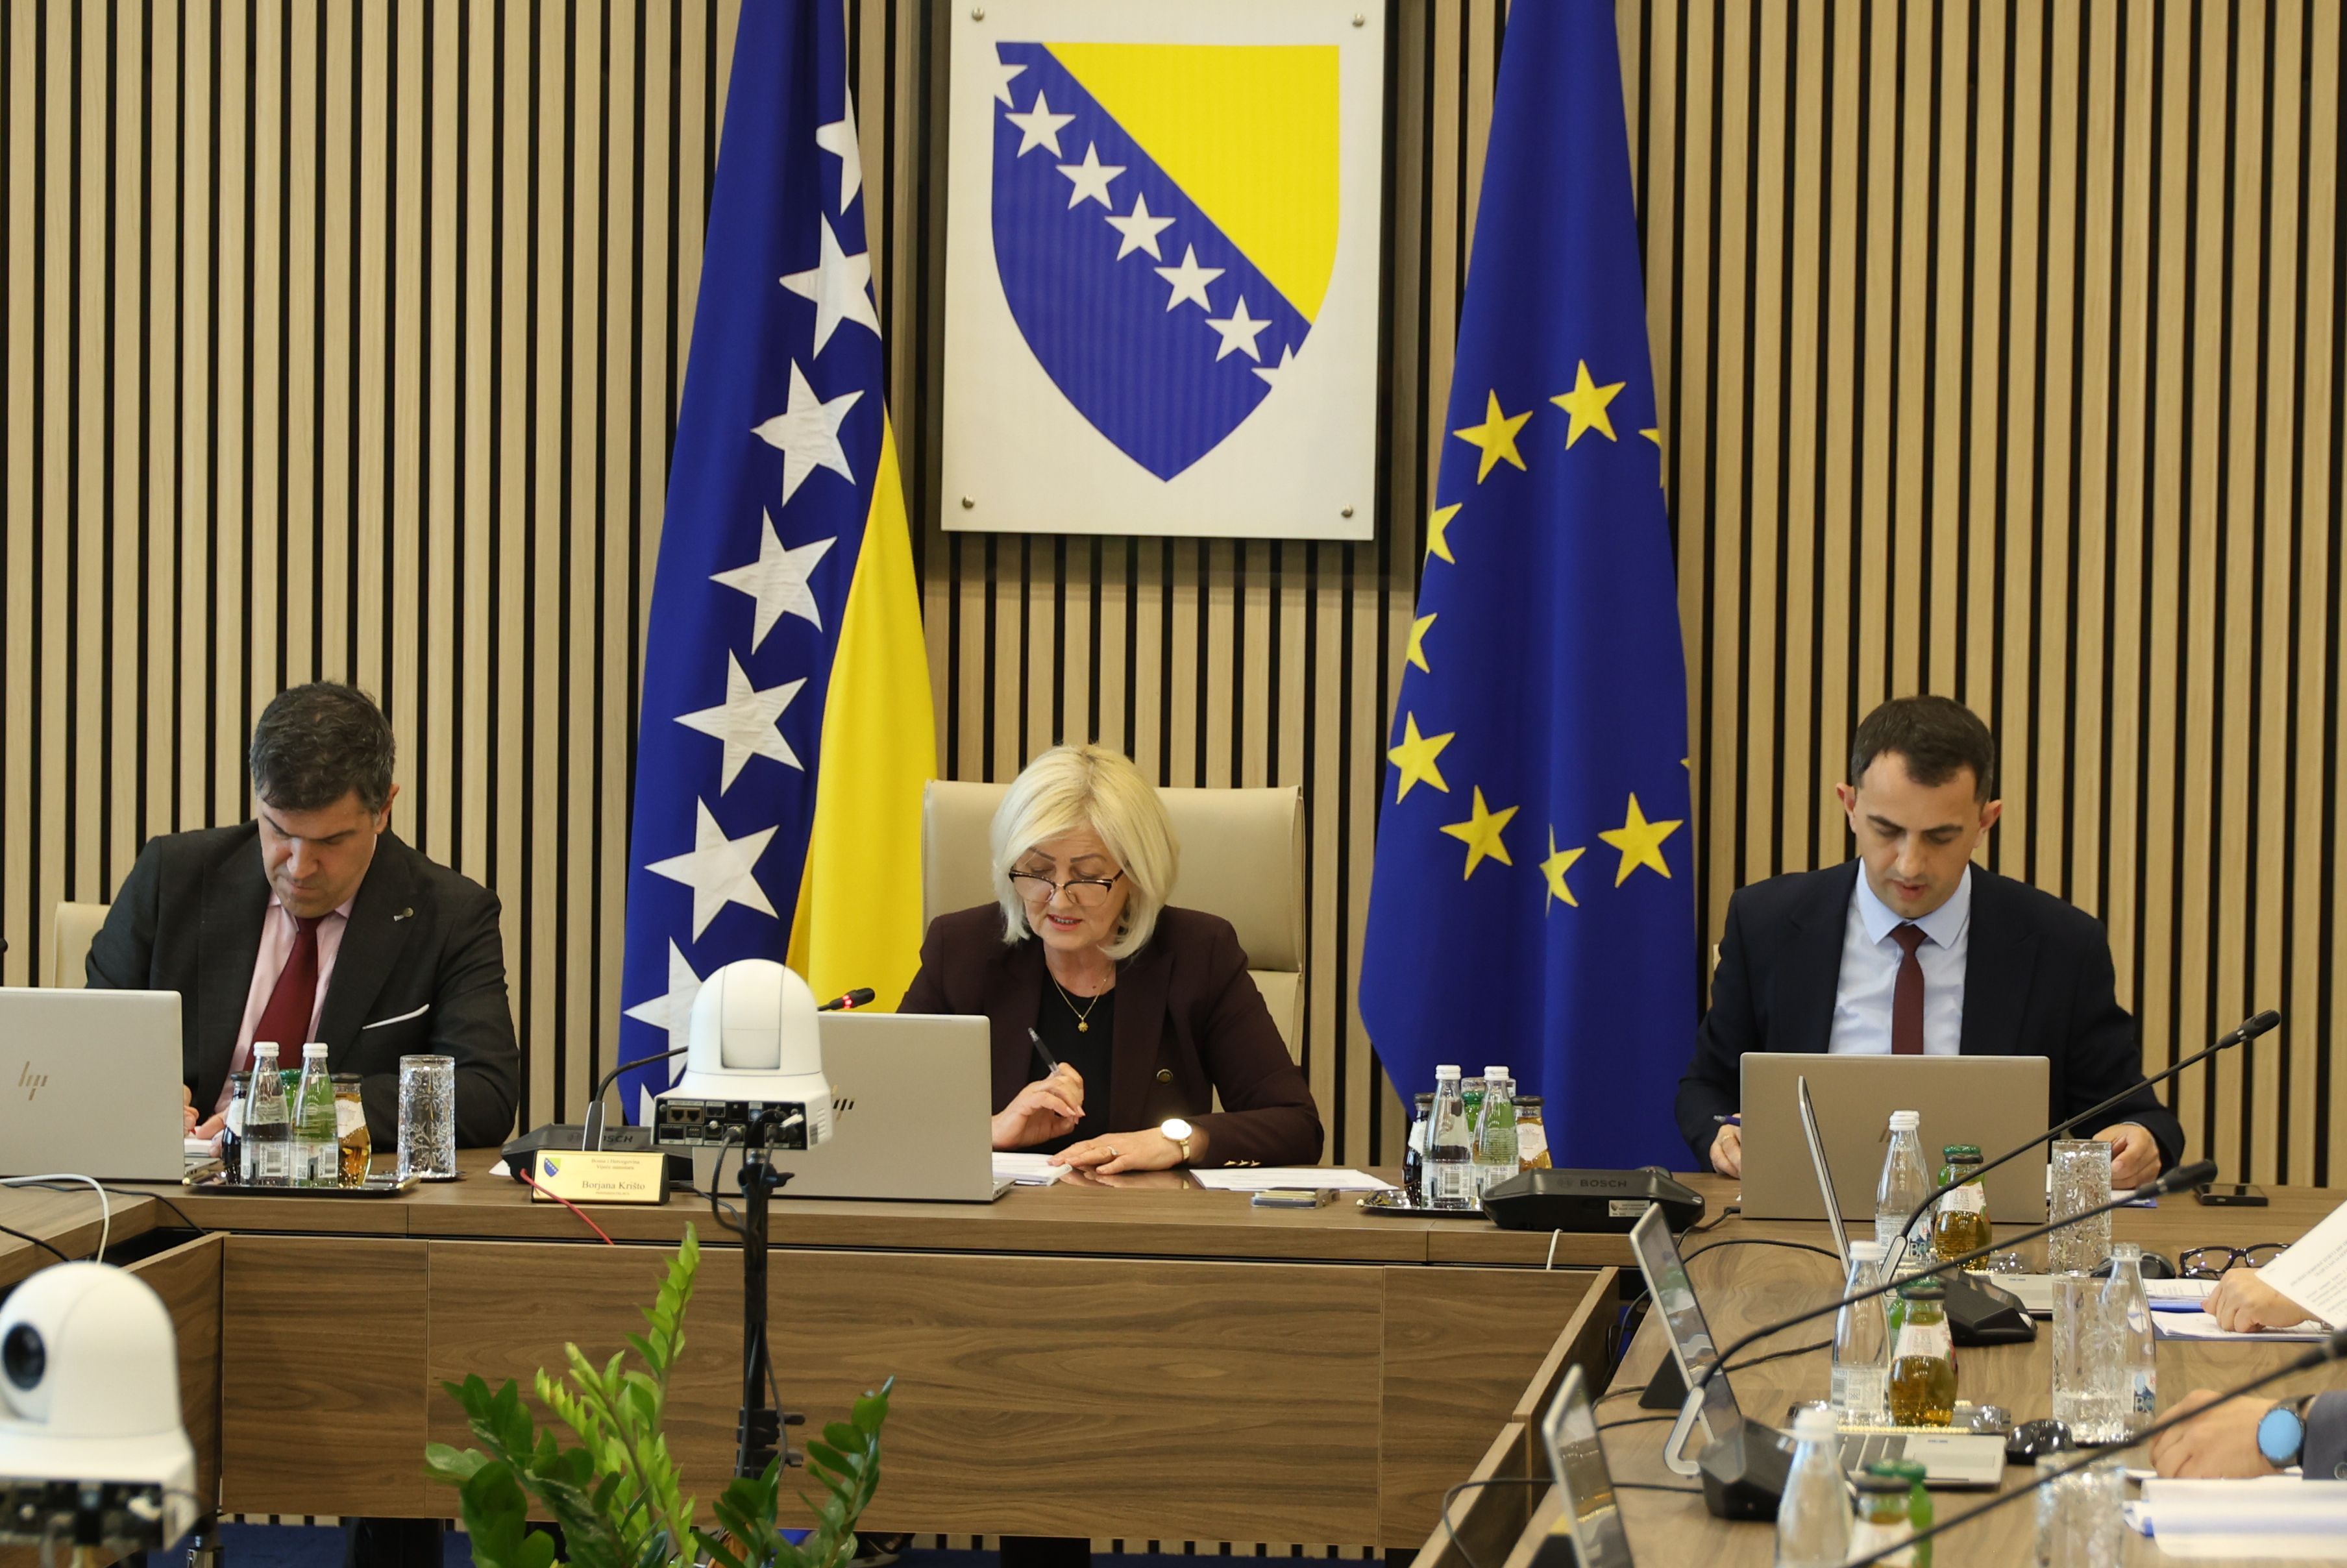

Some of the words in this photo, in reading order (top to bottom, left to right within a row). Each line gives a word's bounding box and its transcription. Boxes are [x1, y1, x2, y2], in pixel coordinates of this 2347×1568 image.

[18, 1060, 48, 1101] hp
[582, 1180, 615, 1190] Borjana
[619, 1181, 645, 1190] Krišto
[1580, 1179, 1627, 1188] BOSCH
